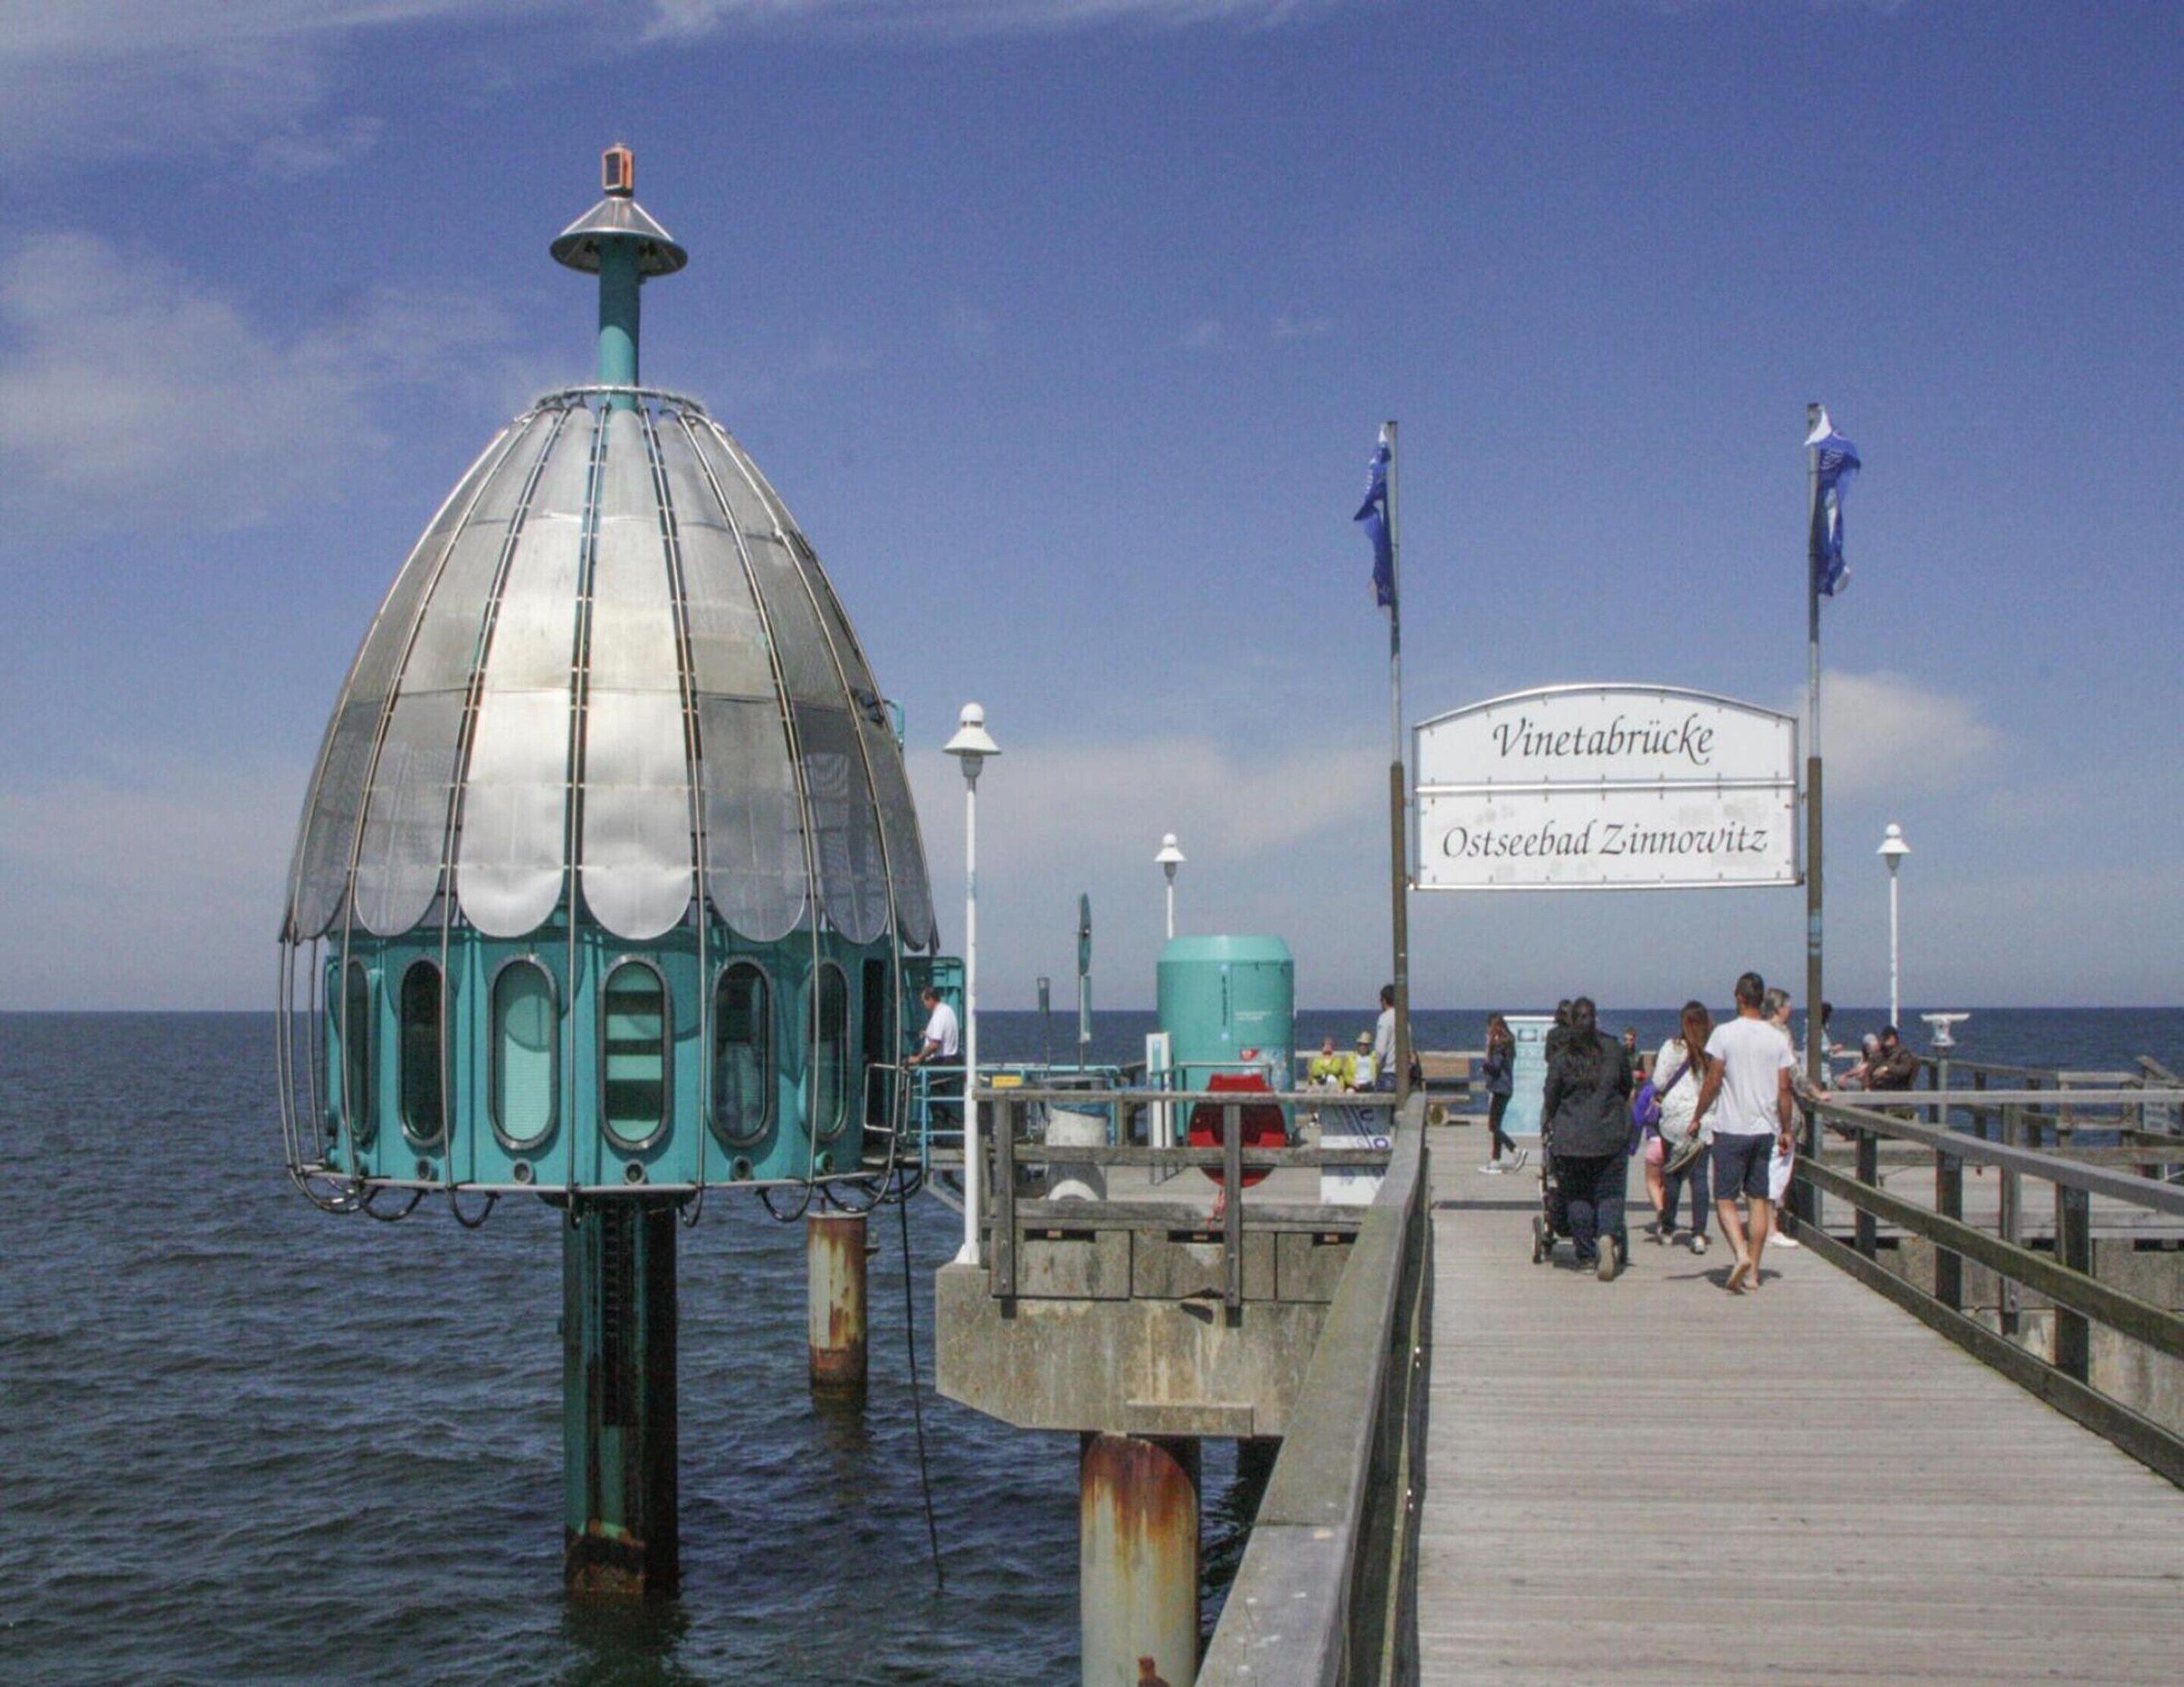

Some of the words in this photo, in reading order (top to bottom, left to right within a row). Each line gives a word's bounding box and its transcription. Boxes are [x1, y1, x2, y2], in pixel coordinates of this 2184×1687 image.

[1492, 713, 1715, 766] Vinetabrücke
[1442, 819, 1597, 858] Ostseebad
[1599, 820, 1768, 856] Zinnowitz
